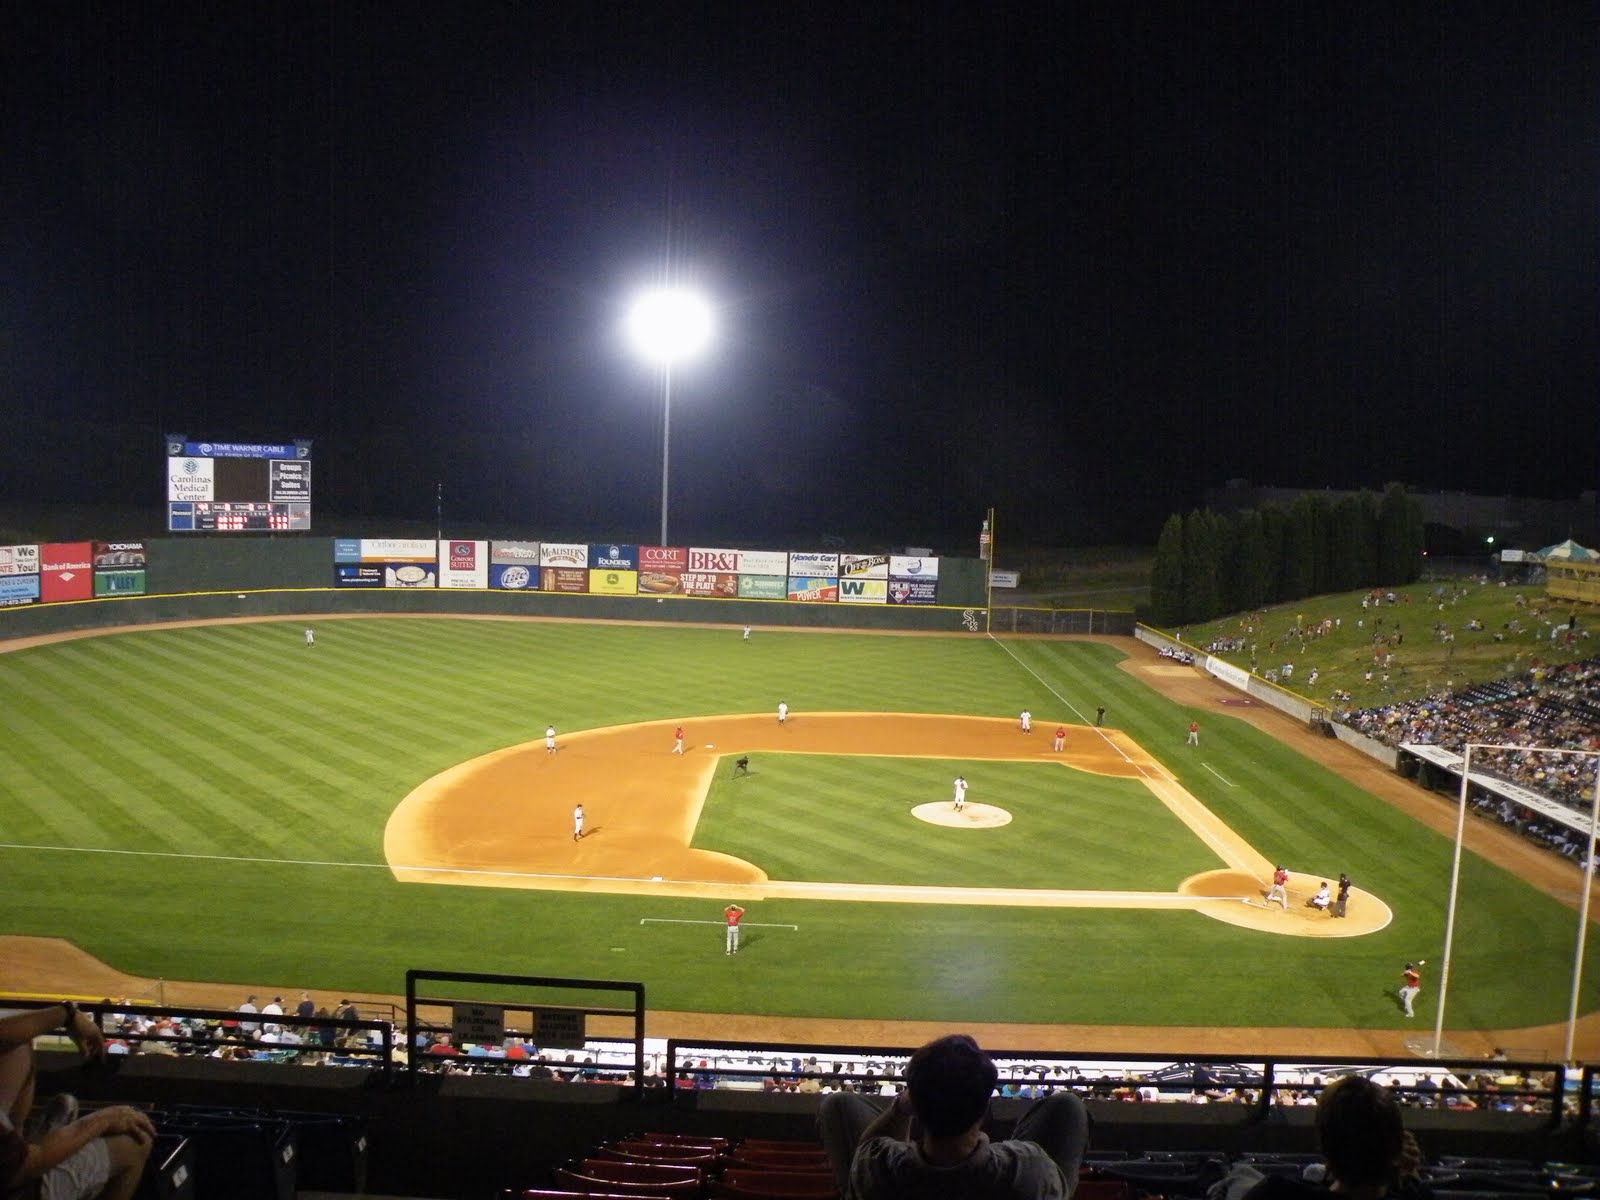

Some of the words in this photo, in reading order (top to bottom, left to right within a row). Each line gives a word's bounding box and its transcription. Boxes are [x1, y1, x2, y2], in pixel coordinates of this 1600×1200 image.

[213, 443, 231, 451] TIME
[232, 444, 262, 453] WARNER
[171, 475, 212, 484] Carolinas
[280, 472, 303, 480] Picnics
[174, 484, 209, 492] Medical
[177, 493, 206, 501] Center
[108, 543, 144, 551] YOKOHAMA
[17, 547, 36, 557] We
[514, 548, 537, 558] LIGHT
[646, 549, 680, 560] CORT
[450, 554, 475, 562] COMFORT
[598, 557, 631, 566] FOUNDERS
[690, 551, 743, 571] BB&T
[791, 554, 818, 563] Honda
[17, 563, 37, 572] You!
[43, 562, 60, 571] Bank
[60, 562, 66, 570] of
[450, 561, 476, 569] SUITES
[680, 573, 697, 582] STEP
[697, 574, 707, 583] UP
[707, 574, 717, 583] TO
[682, 581, 695, 590] THE
[696, 582, 715, 591] PLATE
[796, 590, 821, 602] POWER
